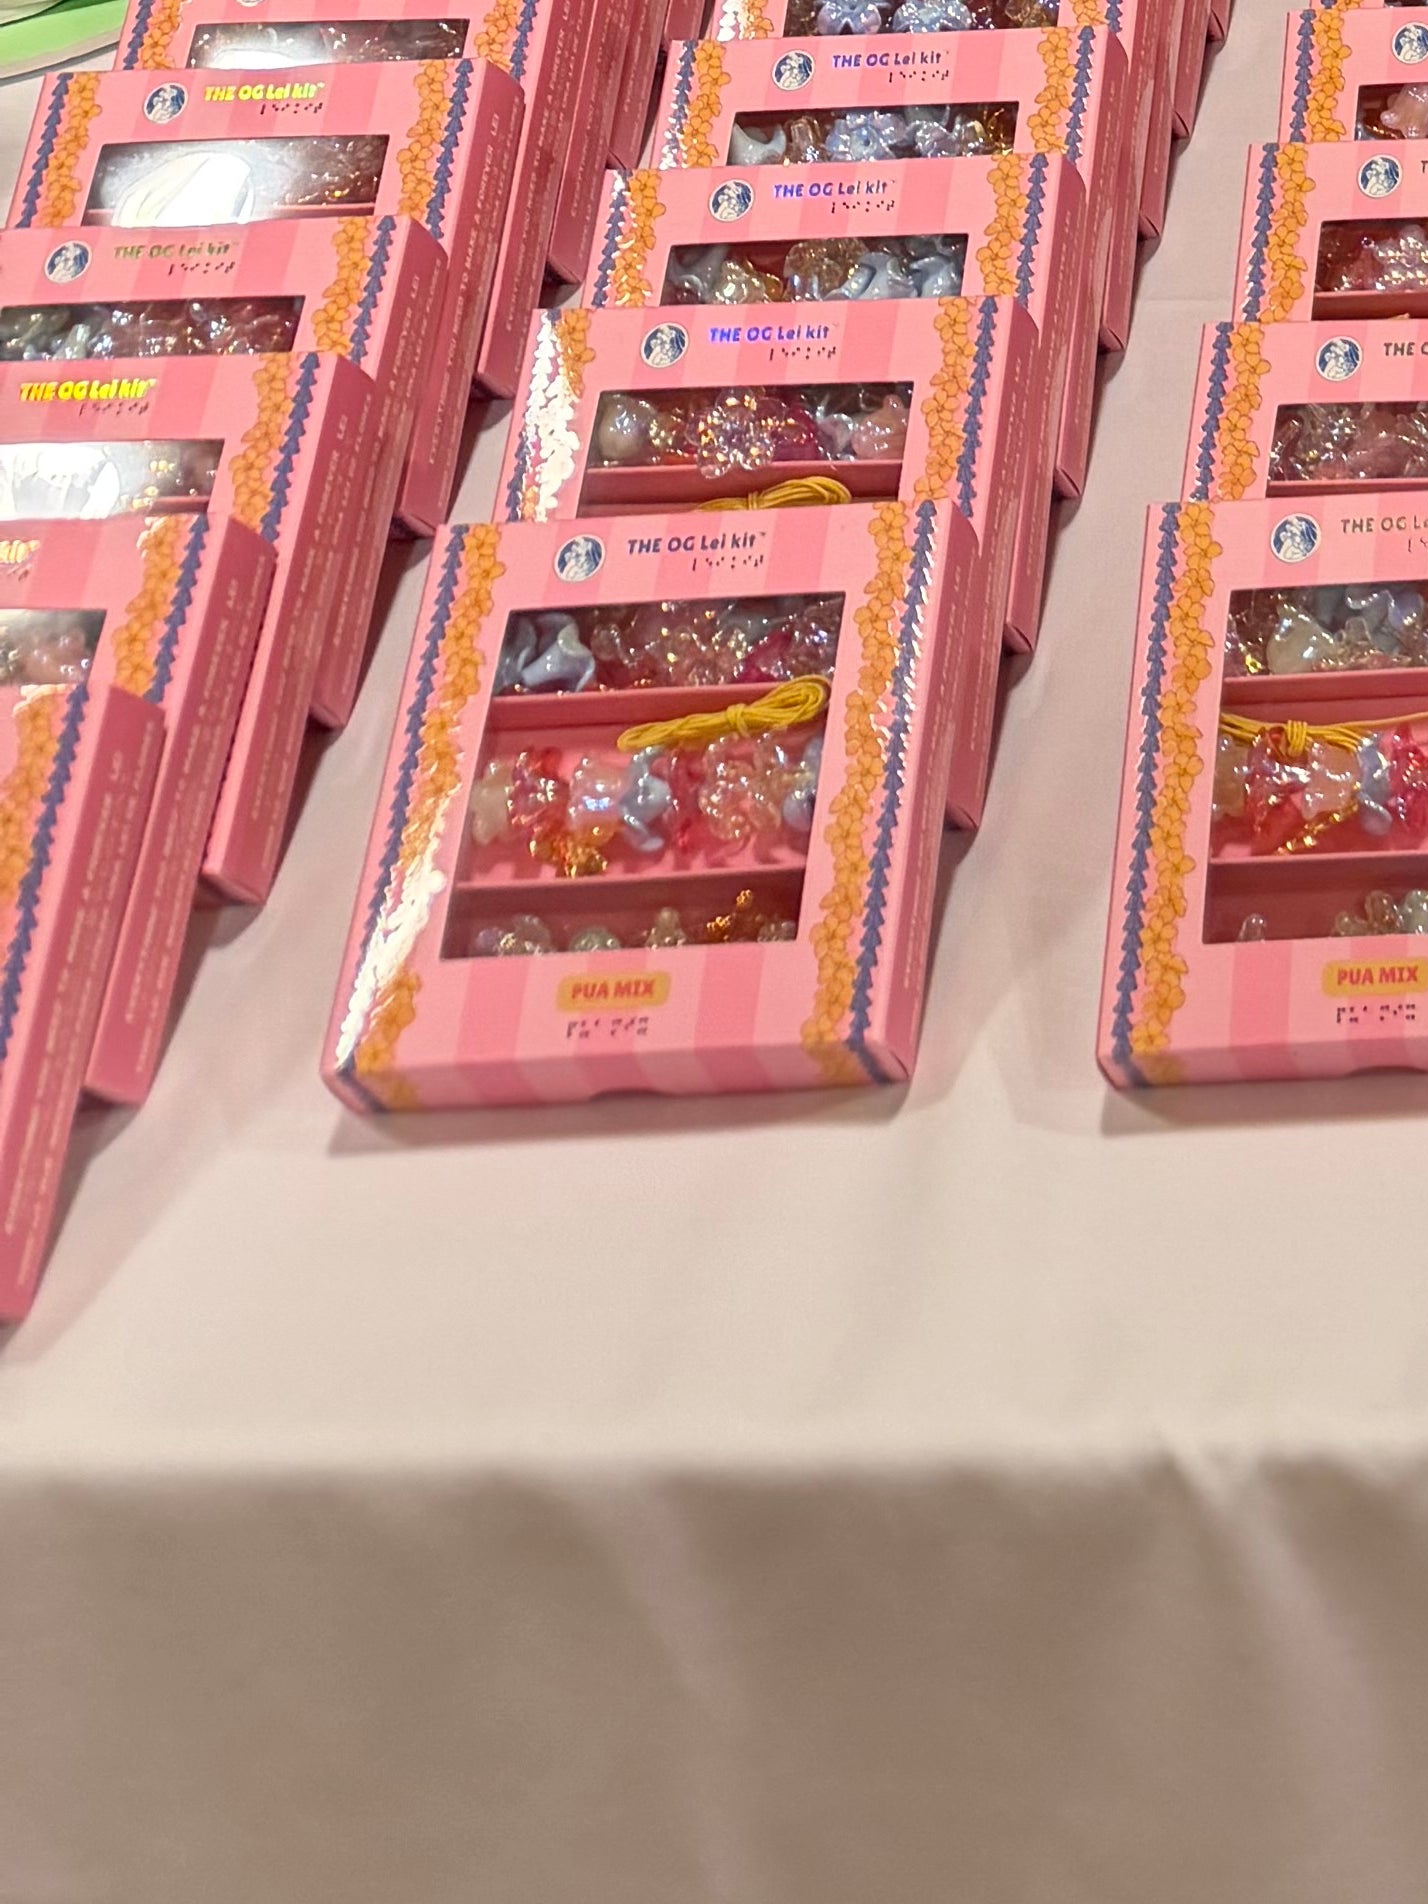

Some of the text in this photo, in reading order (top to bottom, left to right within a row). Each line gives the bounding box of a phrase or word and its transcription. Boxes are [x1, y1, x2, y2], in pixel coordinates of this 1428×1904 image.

[833, 55, 861, 68] THE
[866, 53, 889, 67] OG
[894, 52, 916, 66] Lei
[774, 184, 804, 198] THE
[808, 182, 833, 197] OG
[838, 180, 860, 195] Lei
[710, 327, 742, 342] THE
[746, 326, 772, 341] OG
[777, 325, 801, 340] Lei
[628, 538, 662, 554] THE
[667, 536, 695, 552] OG
[700, 534, 726, 551] Lei
[1338, 965, 1418, 985] PUA MIX
[572, 980, 654, 999] PUA MIX
